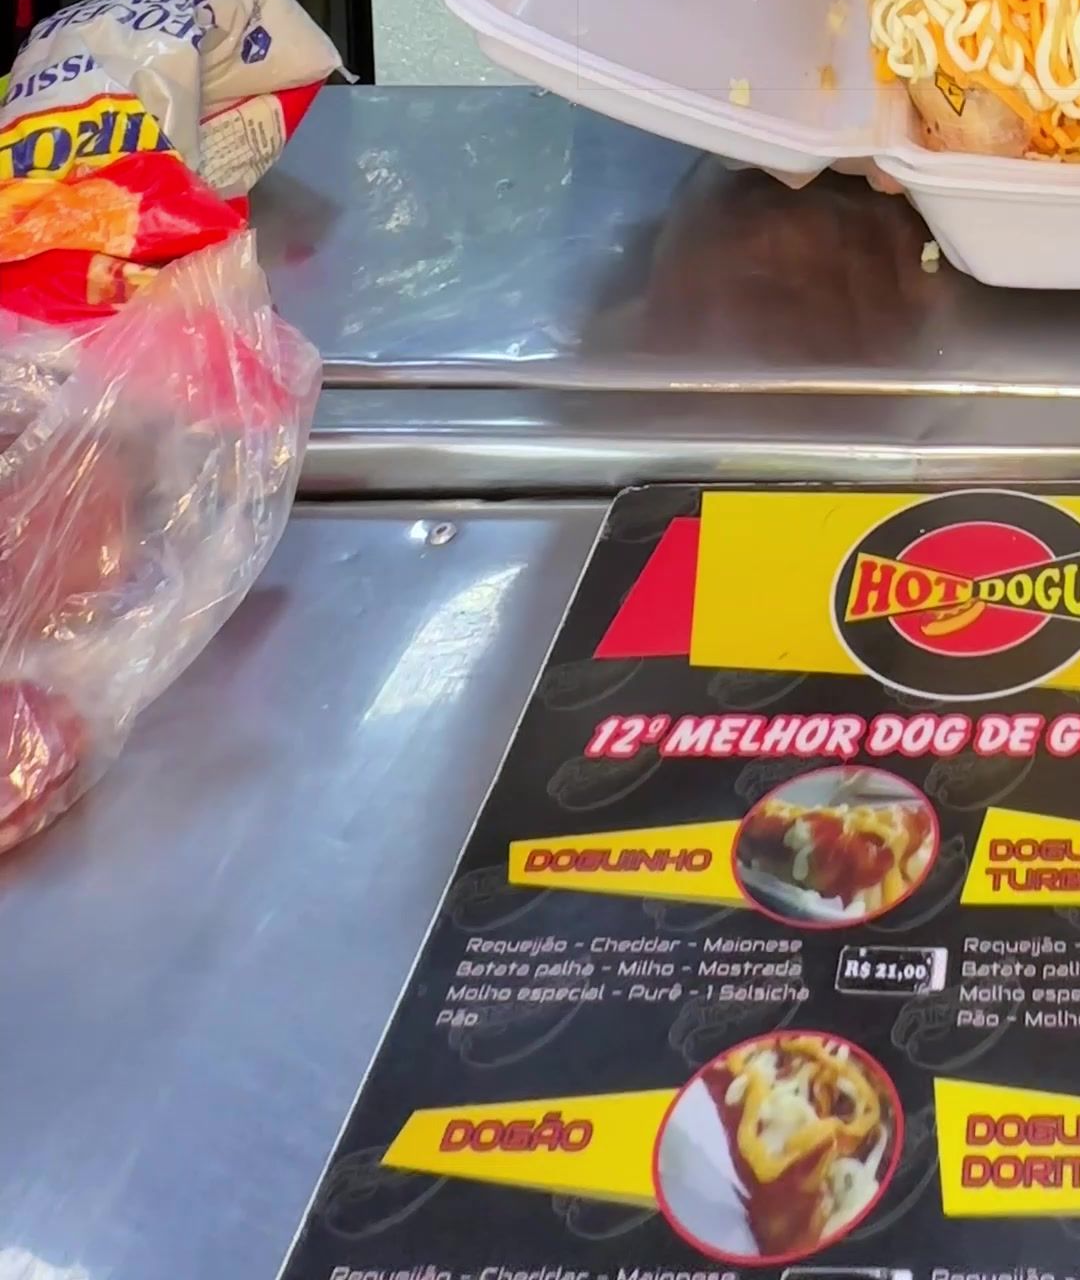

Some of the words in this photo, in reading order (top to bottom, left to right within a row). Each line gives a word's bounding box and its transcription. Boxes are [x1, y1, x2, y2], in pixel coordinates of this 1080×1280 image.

[663, 715, 865, 756] MELHOR
[867, 715, 970, 756] DOG
[975, 715, 1044, 756] DE
[524, 848, 713, 872] DOGUINHO
[465, 936, 567, 956] Requeijão
[590, 937, 681, 953] Cheddar
[703, 937, 803, 953] Maionese
[963, 936, 1067, 957] Requeijão
[456, 960, 530, 977] Batata
[534, 960, 595, 979] palha
[617, 960, 675, 977] Milho
[698, 960, 803, 977] Mostrada
[844, 960, 870, 980] R$
[875, 961, 928, 982] 21,00
[961, 960, 1036, 978] Batata
[446, 985, 511, 1002] Molho
[517, 984, 605, 1003] especial
[628, 983, 682, 1002] Purê
[719, 984, 810, 1002] Salsicha
[959, 985, 1025, 1002] Molho
[436, 1008, 479, 1027] Pão
[956, 1008, 999, 1028] Pão
[440, 1111, 593, 1153] DOGÃO
